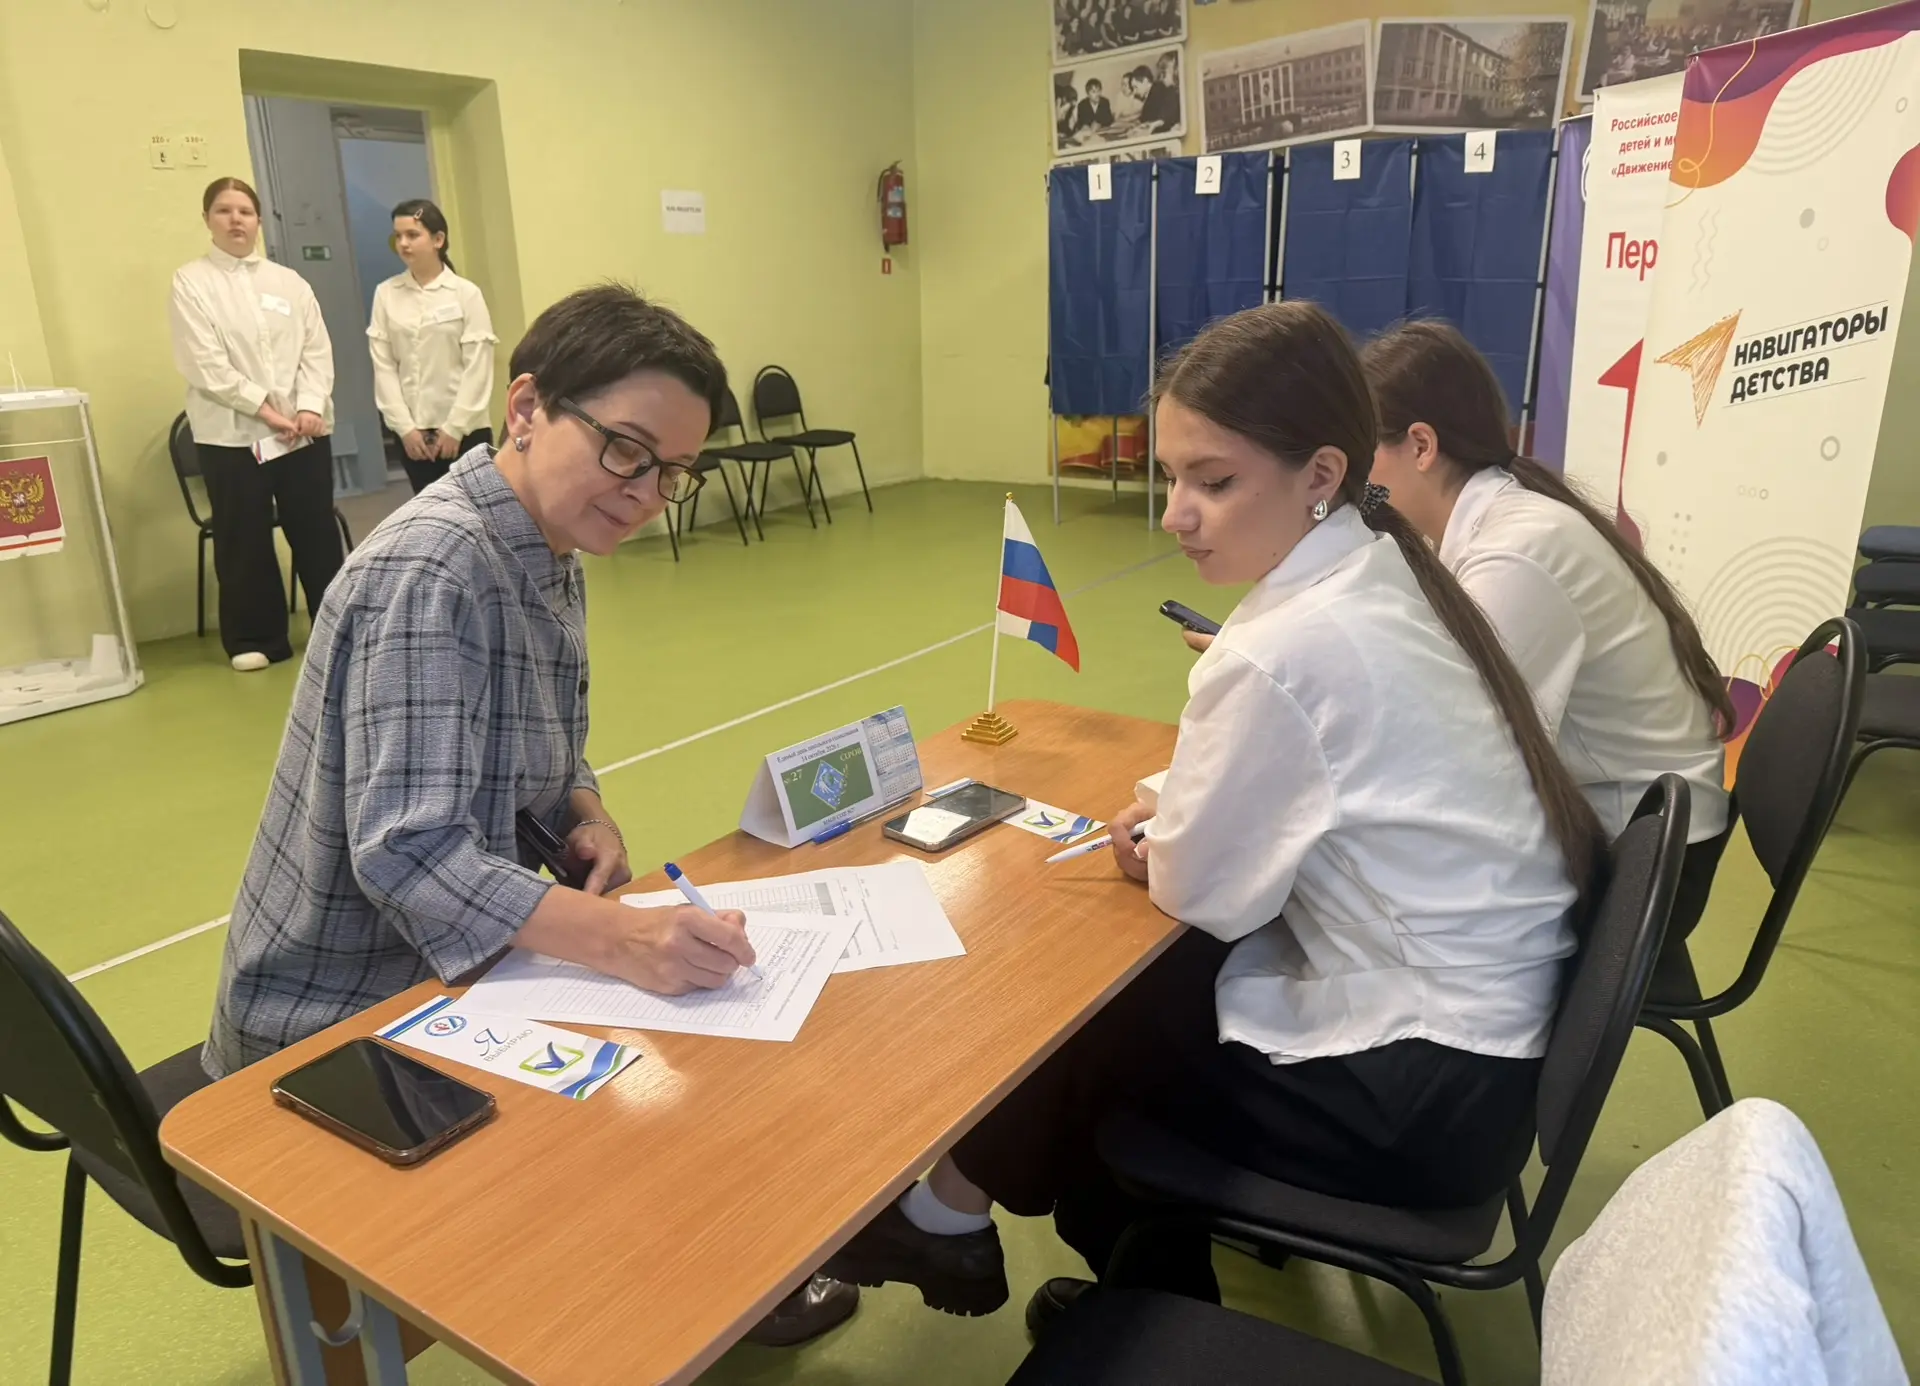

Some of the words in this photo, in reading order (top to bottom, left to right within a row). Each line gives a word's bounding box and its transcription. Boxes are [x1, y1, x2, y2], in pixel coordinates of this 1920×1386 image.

[1611, 112, 1678, 132] Российское
[1474, 142, 1486, 160] 4
[1619, 135, 1651, 155] детей
[1654, 136, 1661, 148] и
[1341, 150, 1350, 169] 3
[1096, 174, 1101, 190] 1
[1204, 166, 1214, 183] 2
[1734, 306, 1889, 367] НАВИГАТОРЫ
[1730, 357, 1830, 404] ДЕТСТВА
[790, 768, 803, 782] 27
[474, 1028, 510, 1057] Я
[484, 1029, 533, 1062] ВЫБИРАЮ
